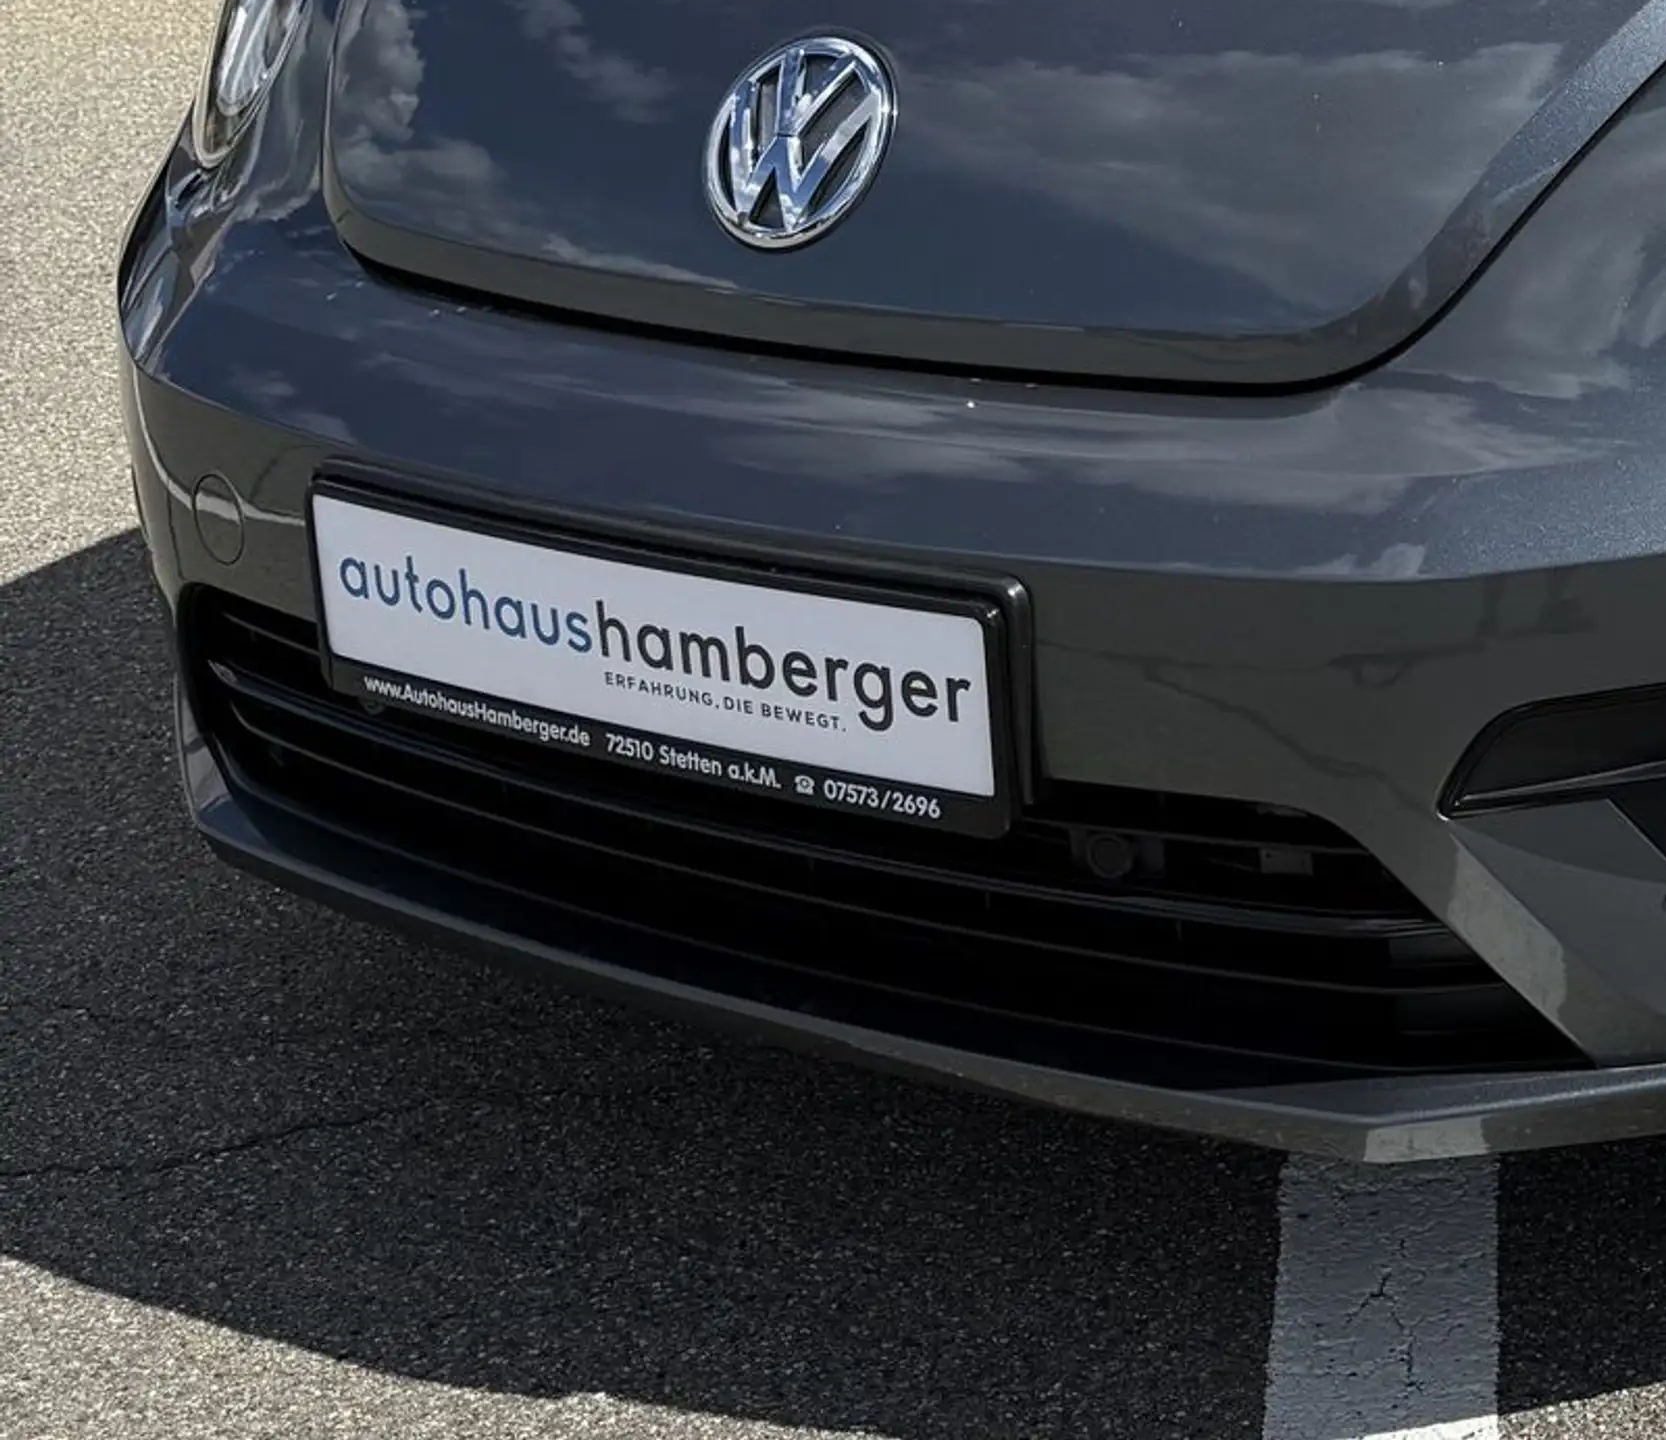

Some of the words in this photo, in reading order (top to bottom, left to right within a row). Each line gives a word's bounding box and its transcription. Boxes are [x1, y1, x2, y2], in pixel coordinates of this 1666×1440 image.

[339, 555, 971, 731] autohaushamberger
[364, 676, 591, 747] www.AutohausHamberger.de
[605, 733, 654, 760] 72510
[659, 745, 722, 777] Stetten
[823, 779, 941, 819] 07573/2696
[761, 703, 847, 732] BEWEGT.
